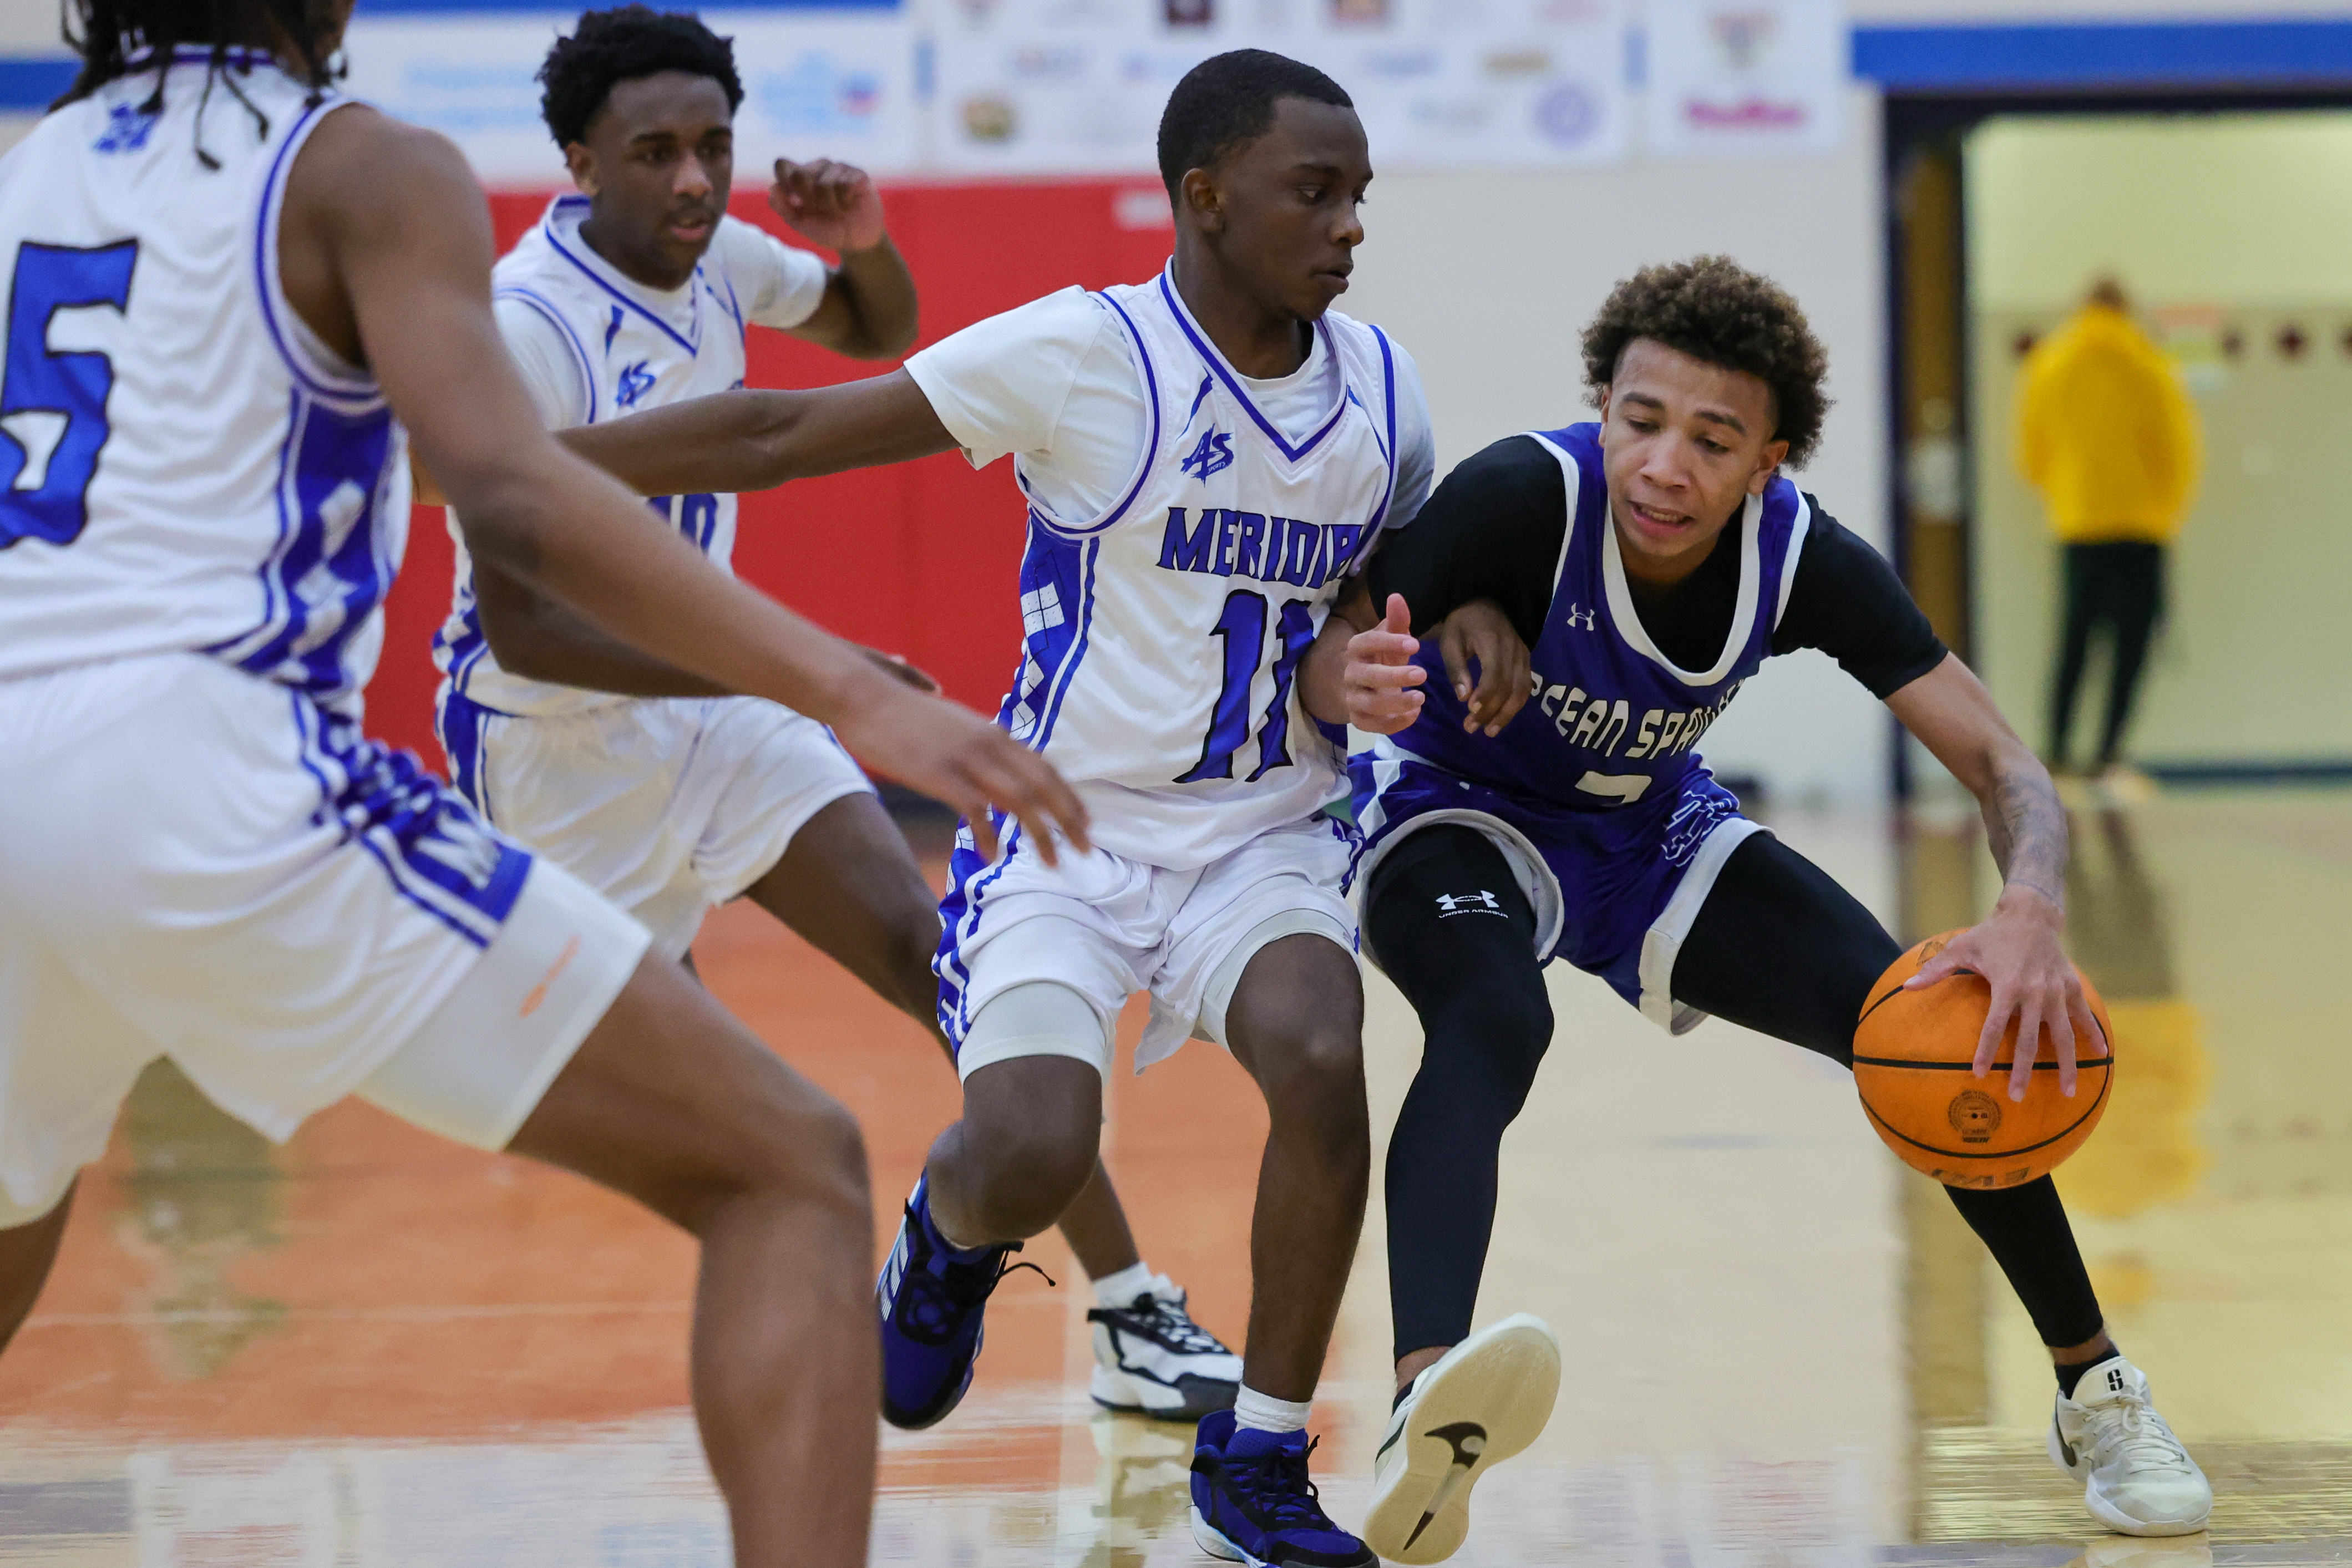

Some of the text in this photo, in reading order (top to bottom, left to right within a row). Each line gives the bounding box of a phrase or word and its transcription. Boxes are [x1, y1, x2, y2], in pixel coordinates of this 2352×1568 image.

[0, 237, 139, 549] 5
[1155, 507, 1365, 589] MERIDIA
[1172, 588, 1316, 783] 11
[1438, 909, 1509, 919] UNDER ARMOUR
